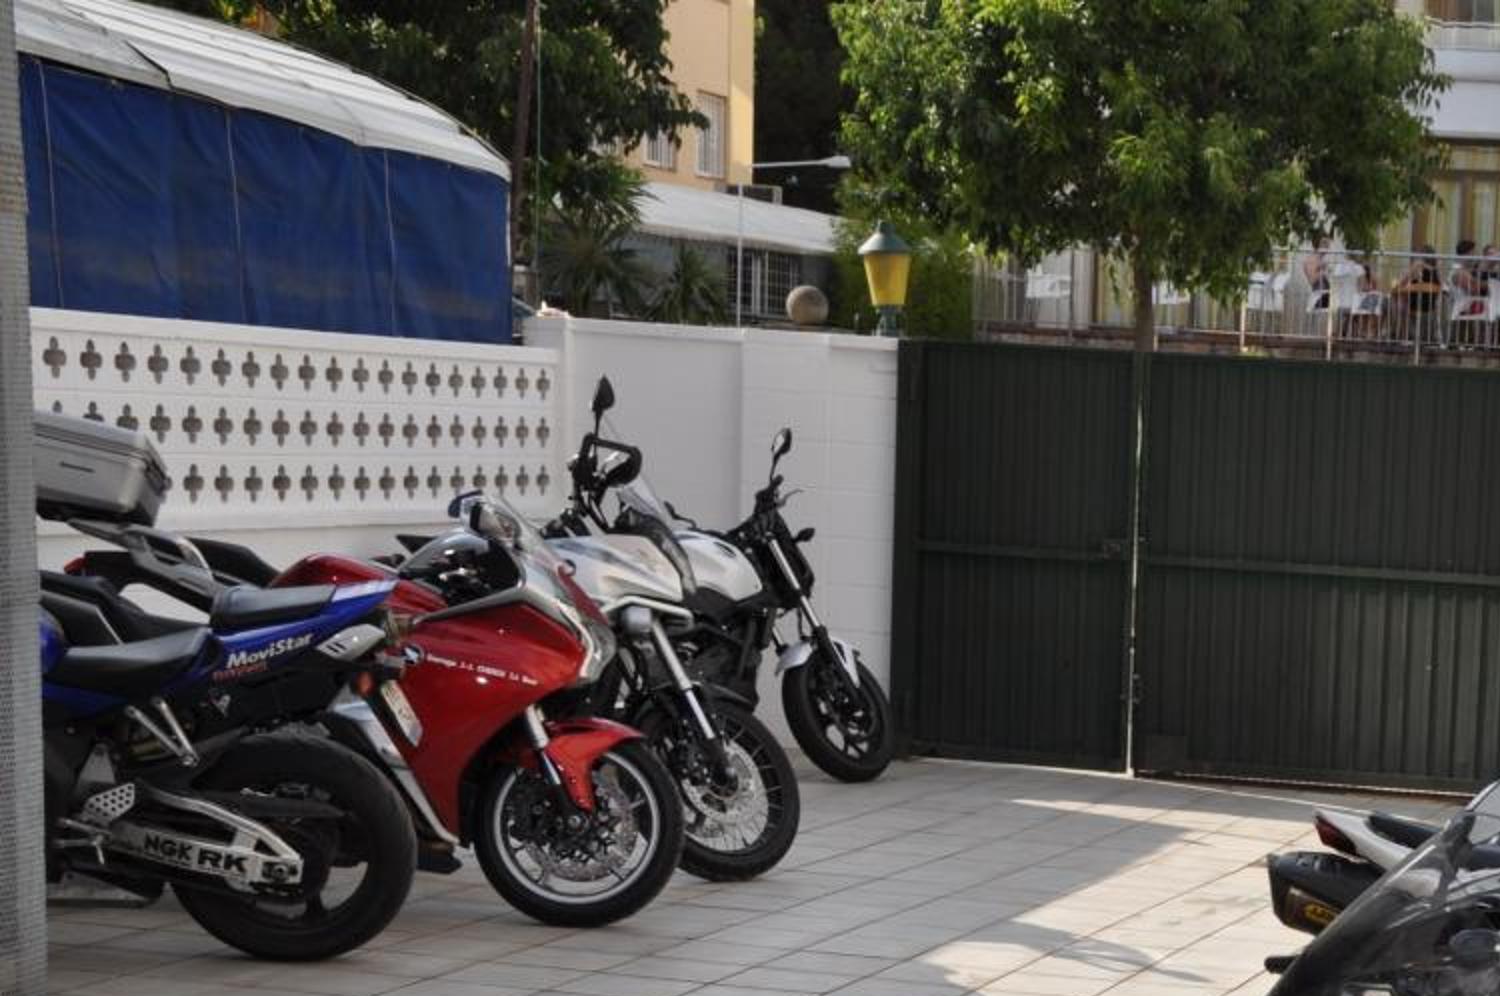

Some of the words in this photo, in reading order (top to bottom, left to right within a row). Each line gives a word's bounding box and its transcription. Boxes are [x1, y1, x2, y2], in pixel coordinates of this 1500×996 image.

[226, 633, 313, 669] MoviStar
[143, 833, 193, 862] NGK
[197, 847, 249, 874] RK
